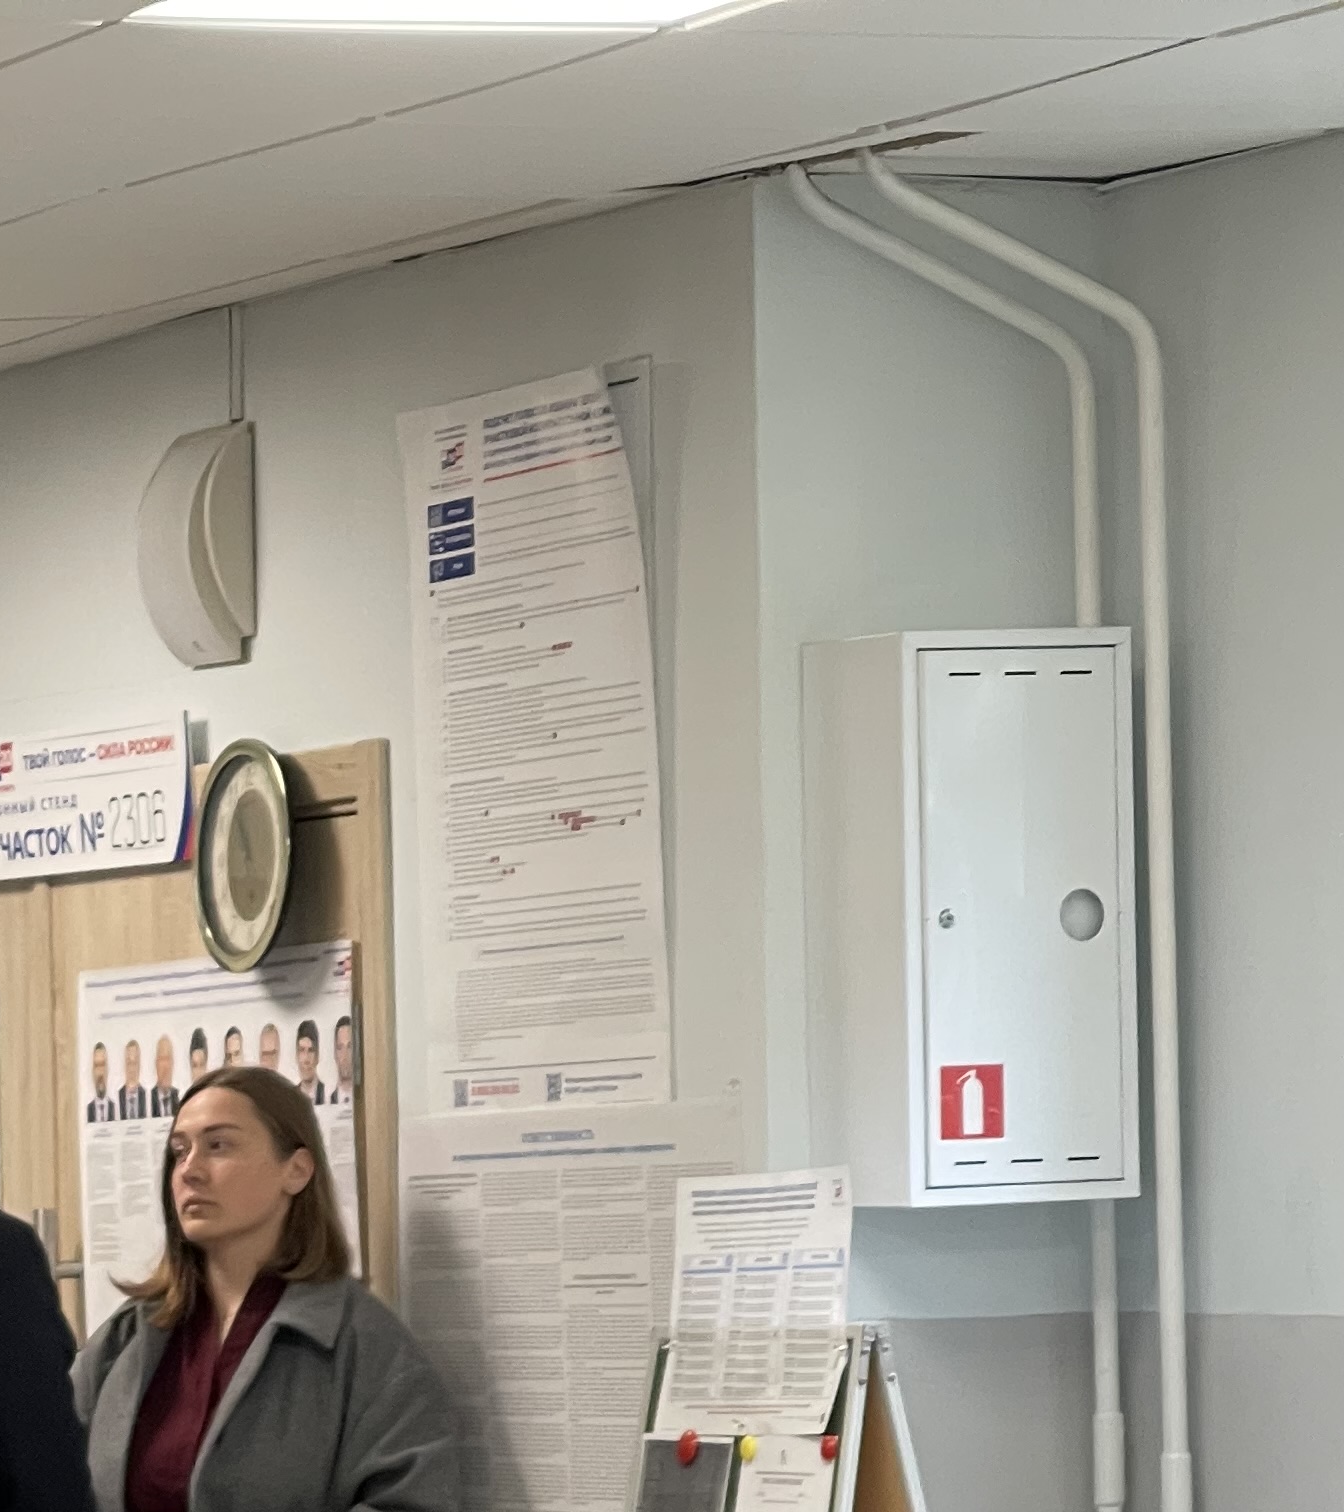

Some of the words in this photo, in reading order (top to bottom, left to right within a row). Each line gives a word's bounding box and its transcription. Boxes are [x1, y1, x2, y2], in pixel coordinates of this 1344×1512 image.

[41, 794, 78, 811] СТЕНД
[79, 811, 104, 854] №
[108, 789, 167, 848] 2306
